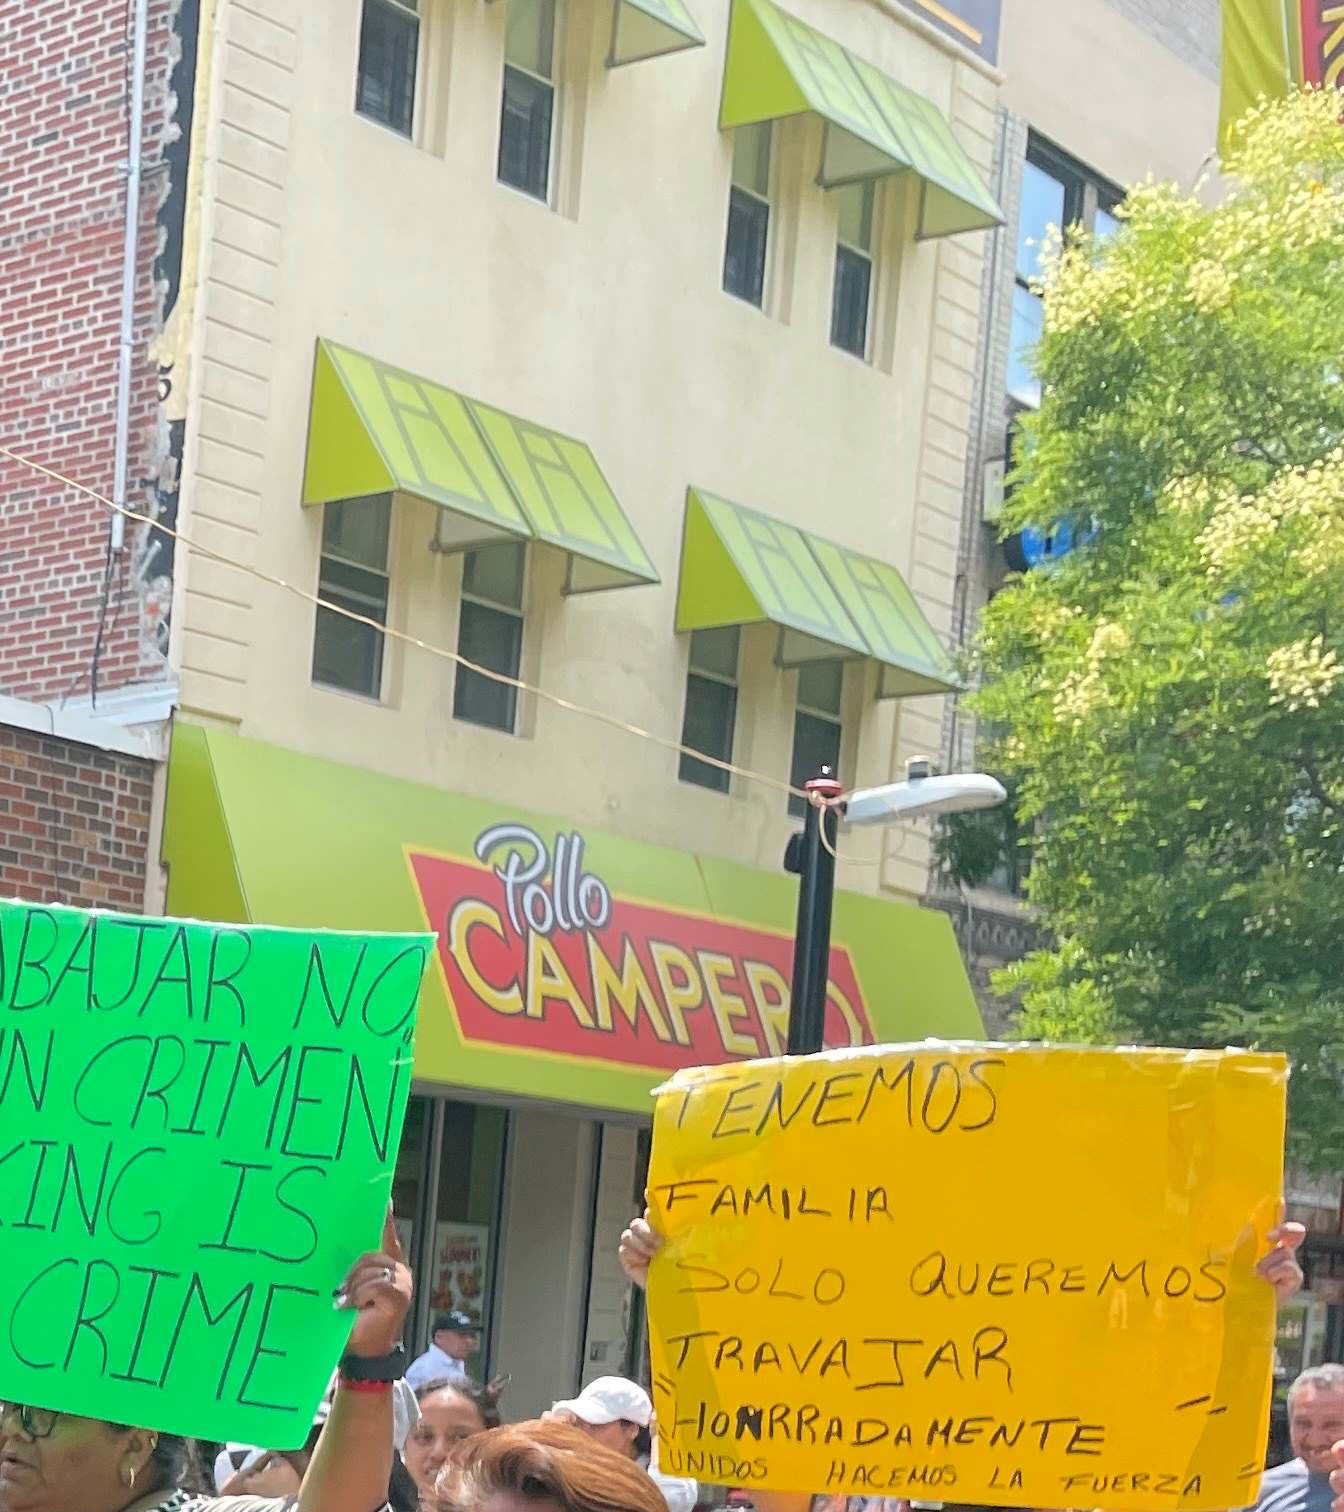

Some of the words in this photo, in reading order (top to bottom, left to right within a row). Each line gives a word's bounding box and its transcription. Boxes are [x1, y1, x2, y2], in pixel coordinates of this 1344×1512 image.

[473, 821, 611, 937] Pollo
[294, 941, 429, 1038] NO
[661, 1058, 1008, 1139] TENEMOS
[198, 1158, 326, 1264] IS
[654, 1179, 895, 1223] FAMILIA
[676, 1255, 847, 1306] SOLO
[909, 1250, 1230, 1303] QUEREMOS
[8, 1257, 321, 1412] CRIME
[666, 1325, 1014, 1392] TRAVAJAR
[669, 1449, 769, 1481] UNIDOS
[825, 1458, 959, 1489] HACEMOS
[989, 1464, 1024, 1490] LA
[1060, 1470, 1203, 1498] FUERZA
